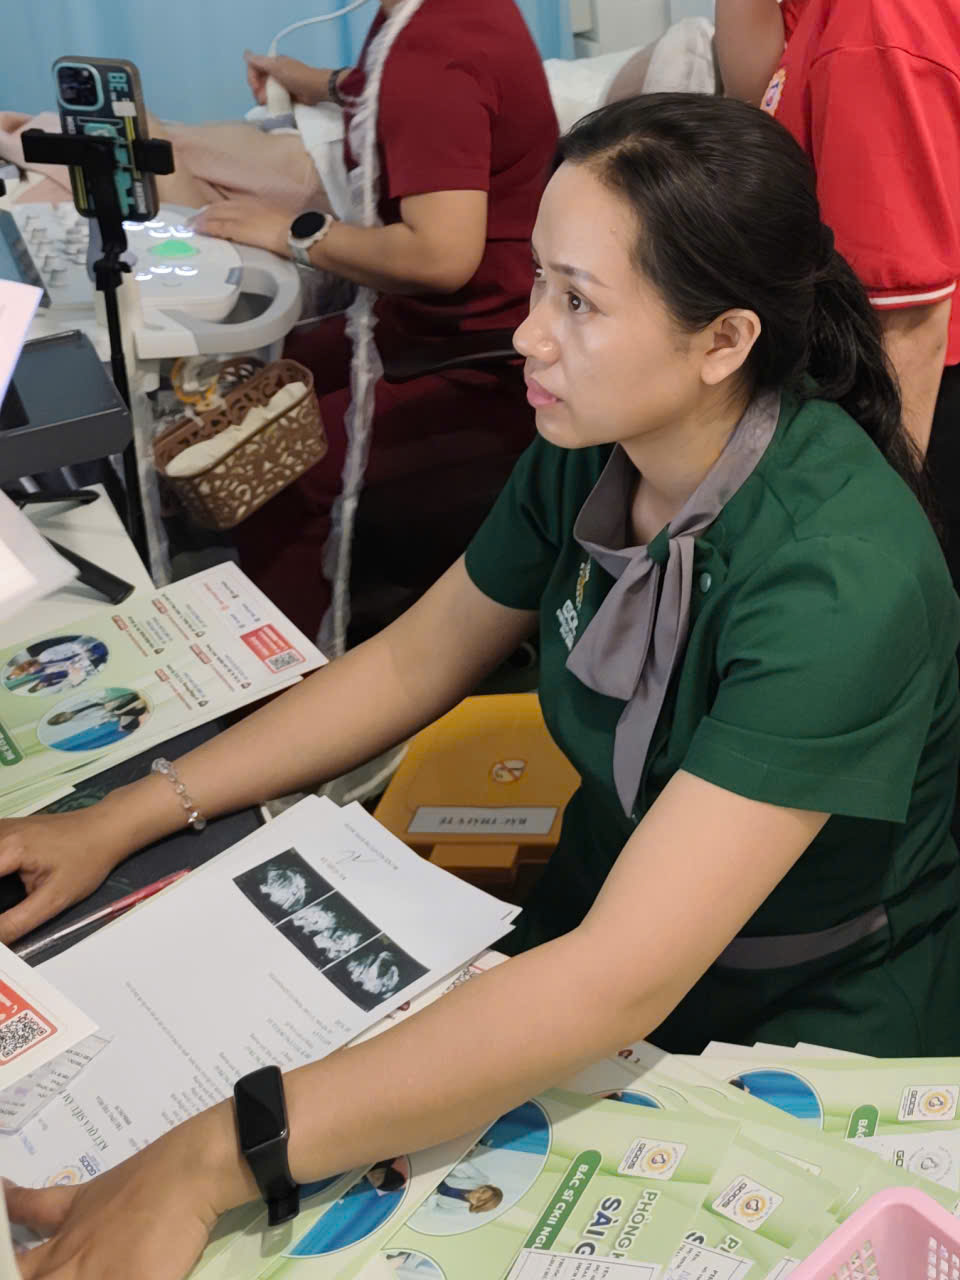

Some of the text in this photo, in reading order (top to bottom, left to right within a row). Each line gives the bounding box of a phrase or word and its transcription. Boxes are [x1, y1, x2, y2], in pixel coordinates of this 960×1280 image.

[569, 1164, 589, 1187] BÁC
[562, 1189, 574, 1202] SĨ
[547, 1202, 566, 1225] CKII
[585, 1197, 622, 1237] SÀI
[617, 1191, 658, 1249] PHÒNG
